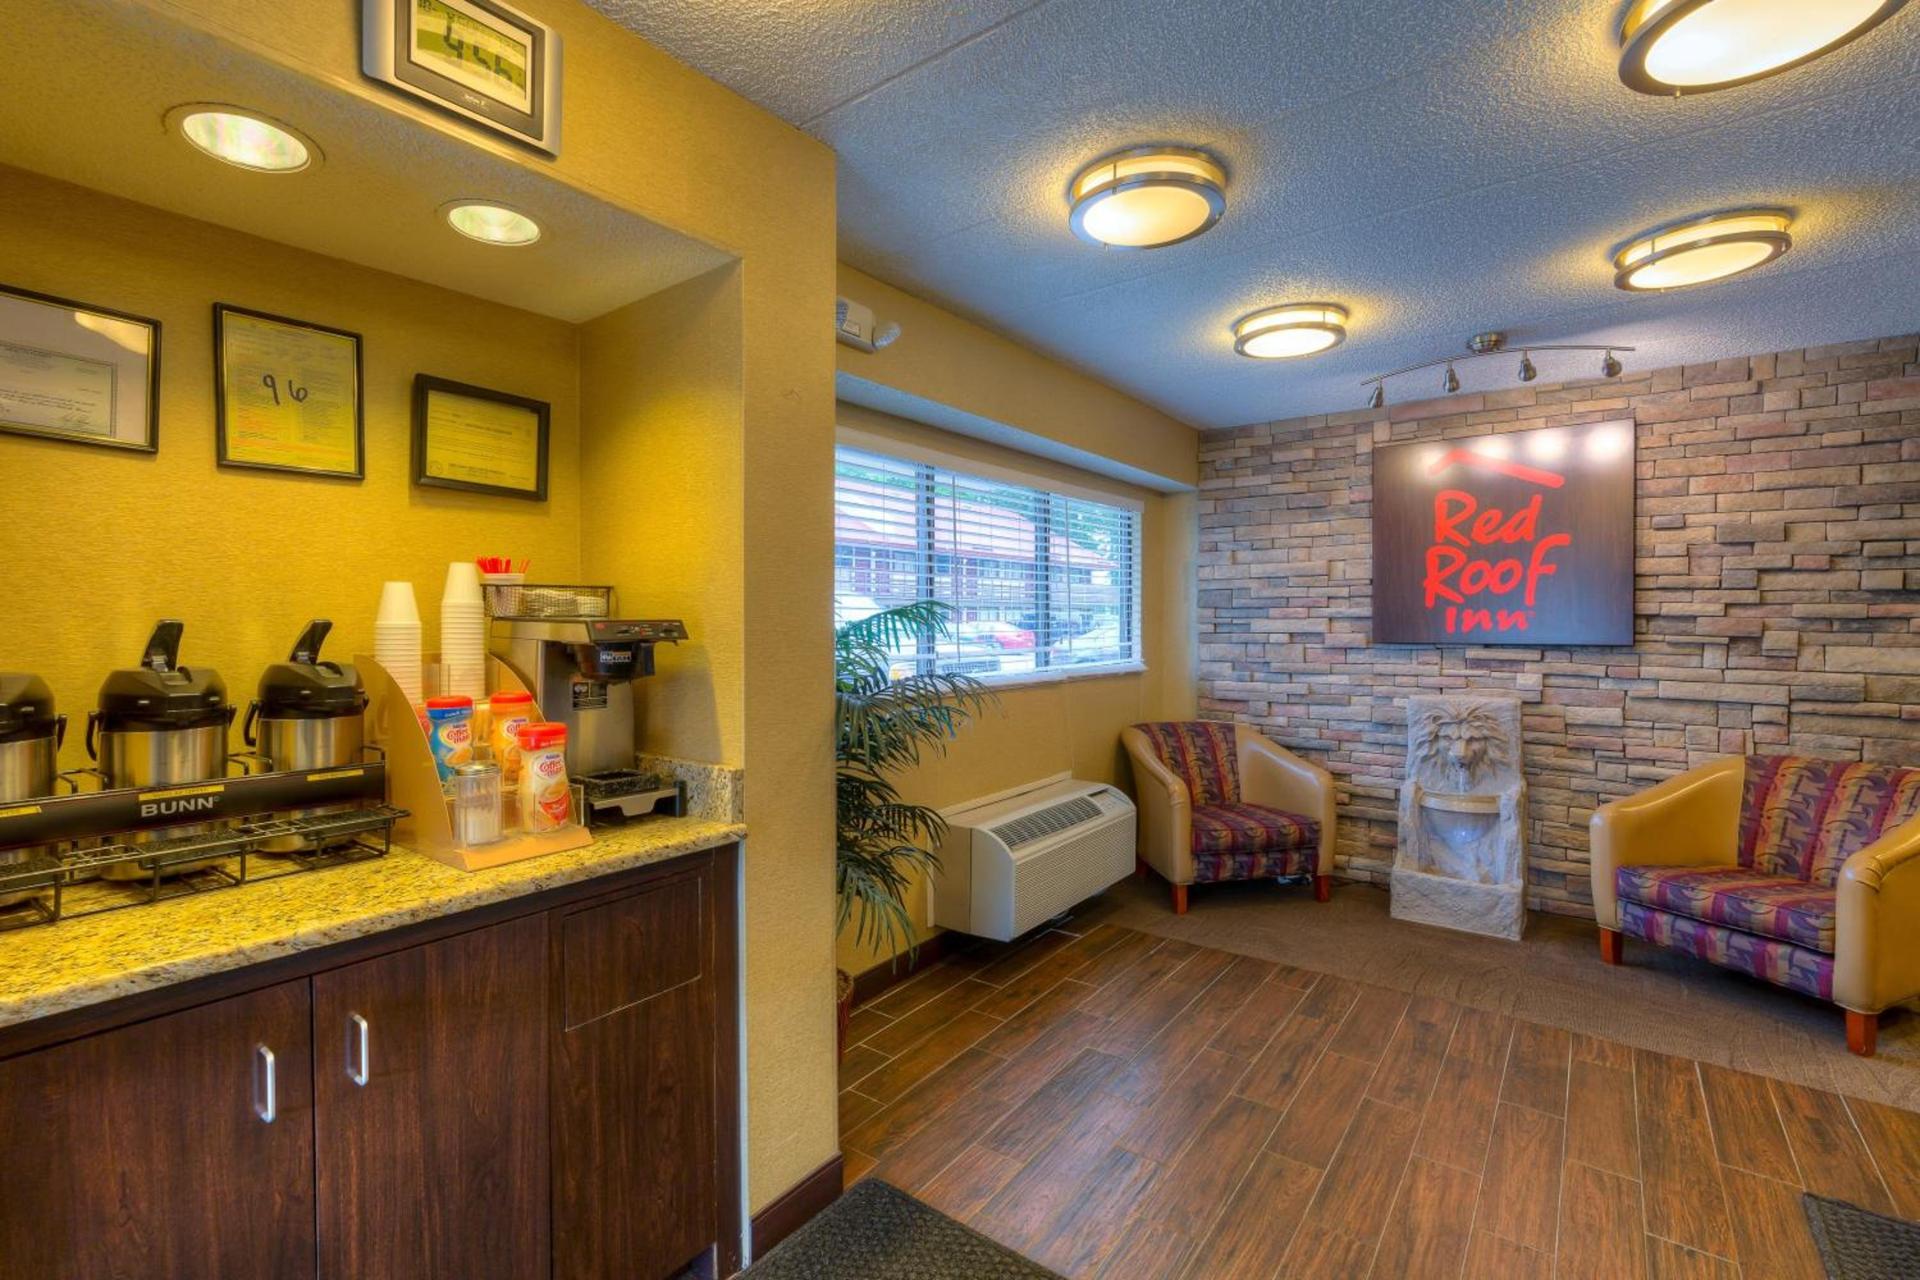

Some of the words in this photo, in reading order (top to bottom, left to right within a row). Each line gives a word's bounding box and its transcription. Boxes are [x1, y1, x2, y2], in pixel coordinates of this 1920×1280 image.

[1434, 489, 1543, 548] Red
[1423, 533, 1572, 609] Roof
[141, 796, 214, 817] BUNN
